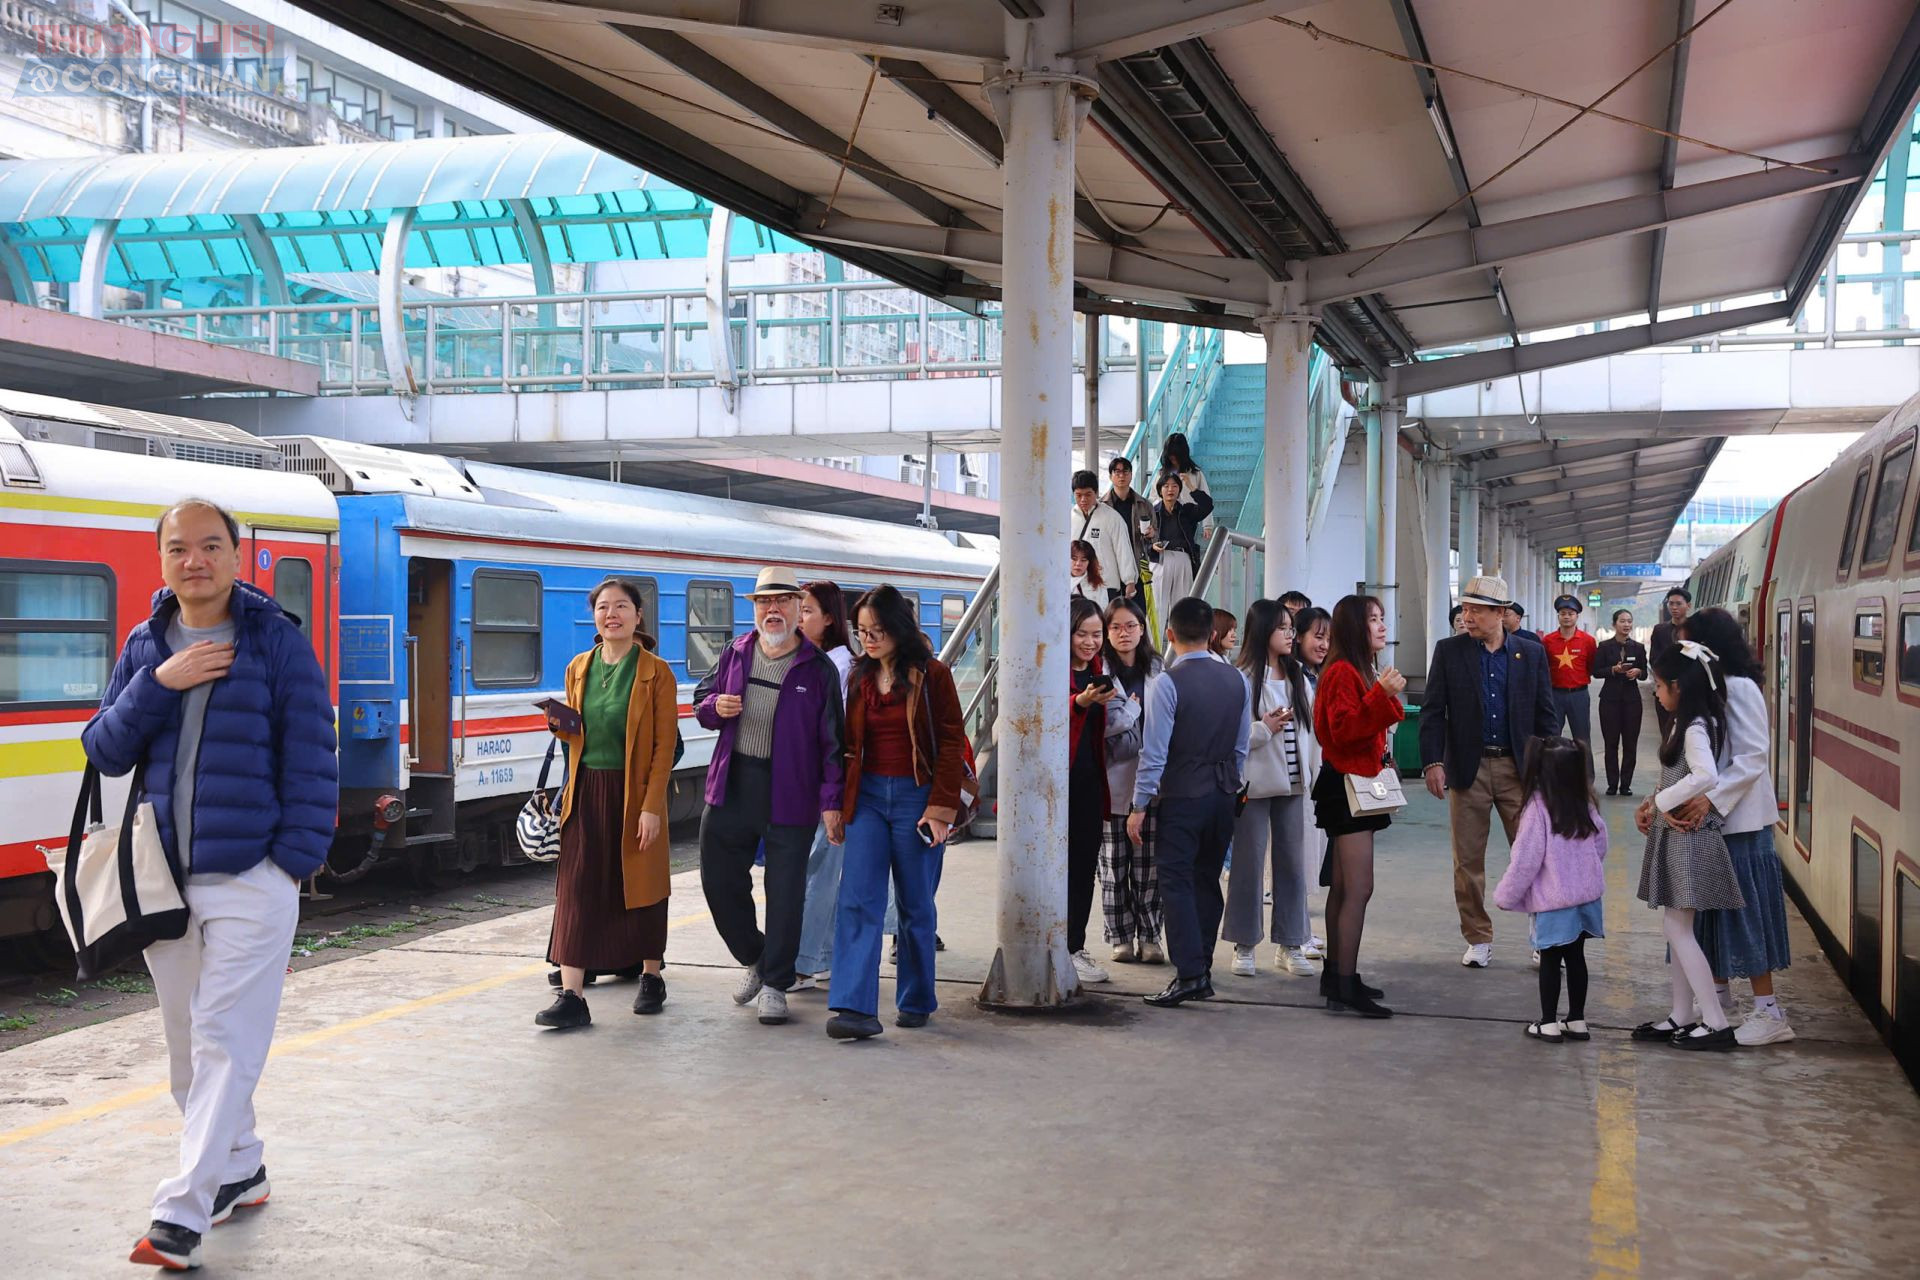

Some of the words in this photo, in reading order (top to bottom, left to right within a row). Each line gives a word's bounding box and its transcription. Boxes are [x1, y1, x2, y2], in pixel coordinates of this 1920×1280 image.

[262, 554, 268, 565] 1
[477, 739, 512, 756] HARACO
[491, 768, 514, 784] 11659
[1372, 782, 1387, 795] B
